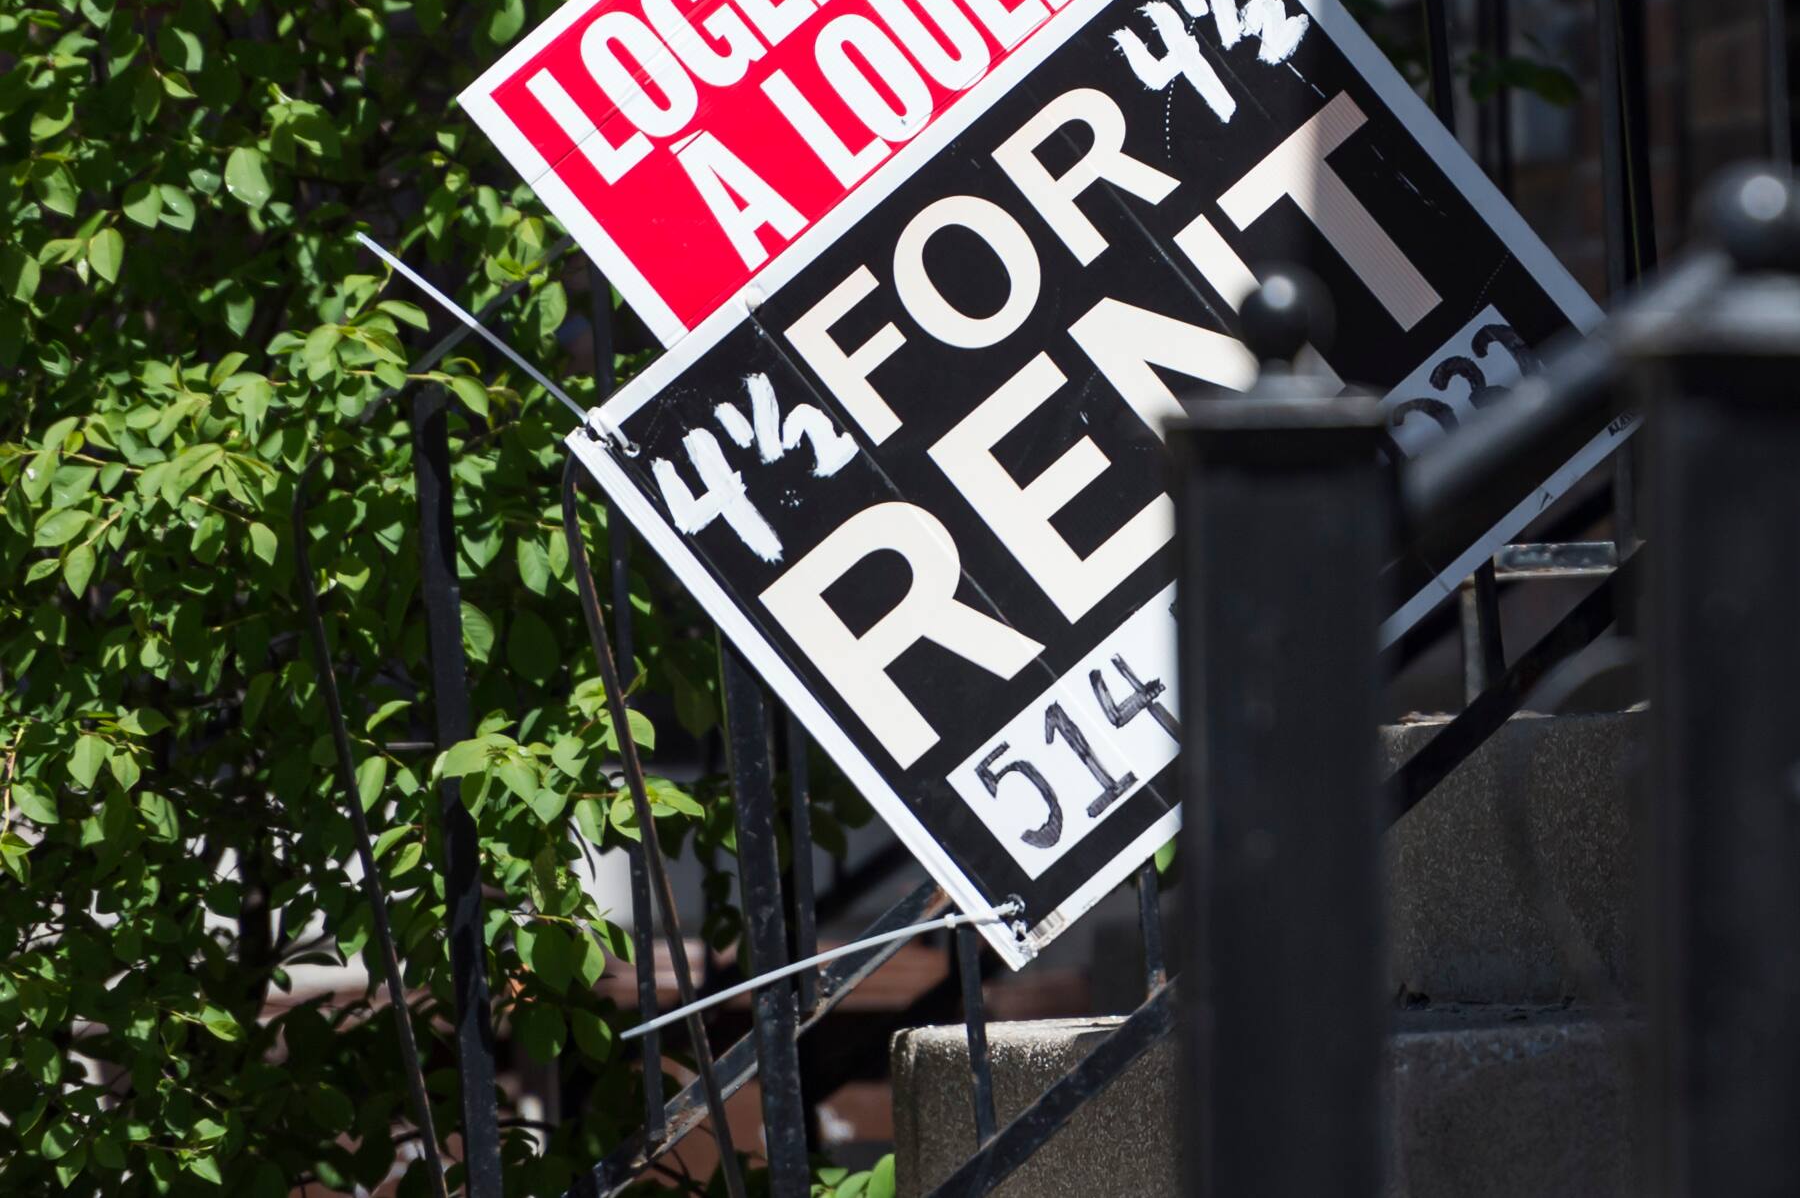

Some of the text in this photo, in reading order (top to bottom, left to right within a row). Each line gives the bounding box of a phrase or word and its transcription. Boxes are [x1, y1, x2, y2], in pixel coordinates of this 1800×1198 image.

[758, 90, 1444, 771] RENT
[783, 88, 1181, 447] FOR
[974, 653, 1182, 849] 514
